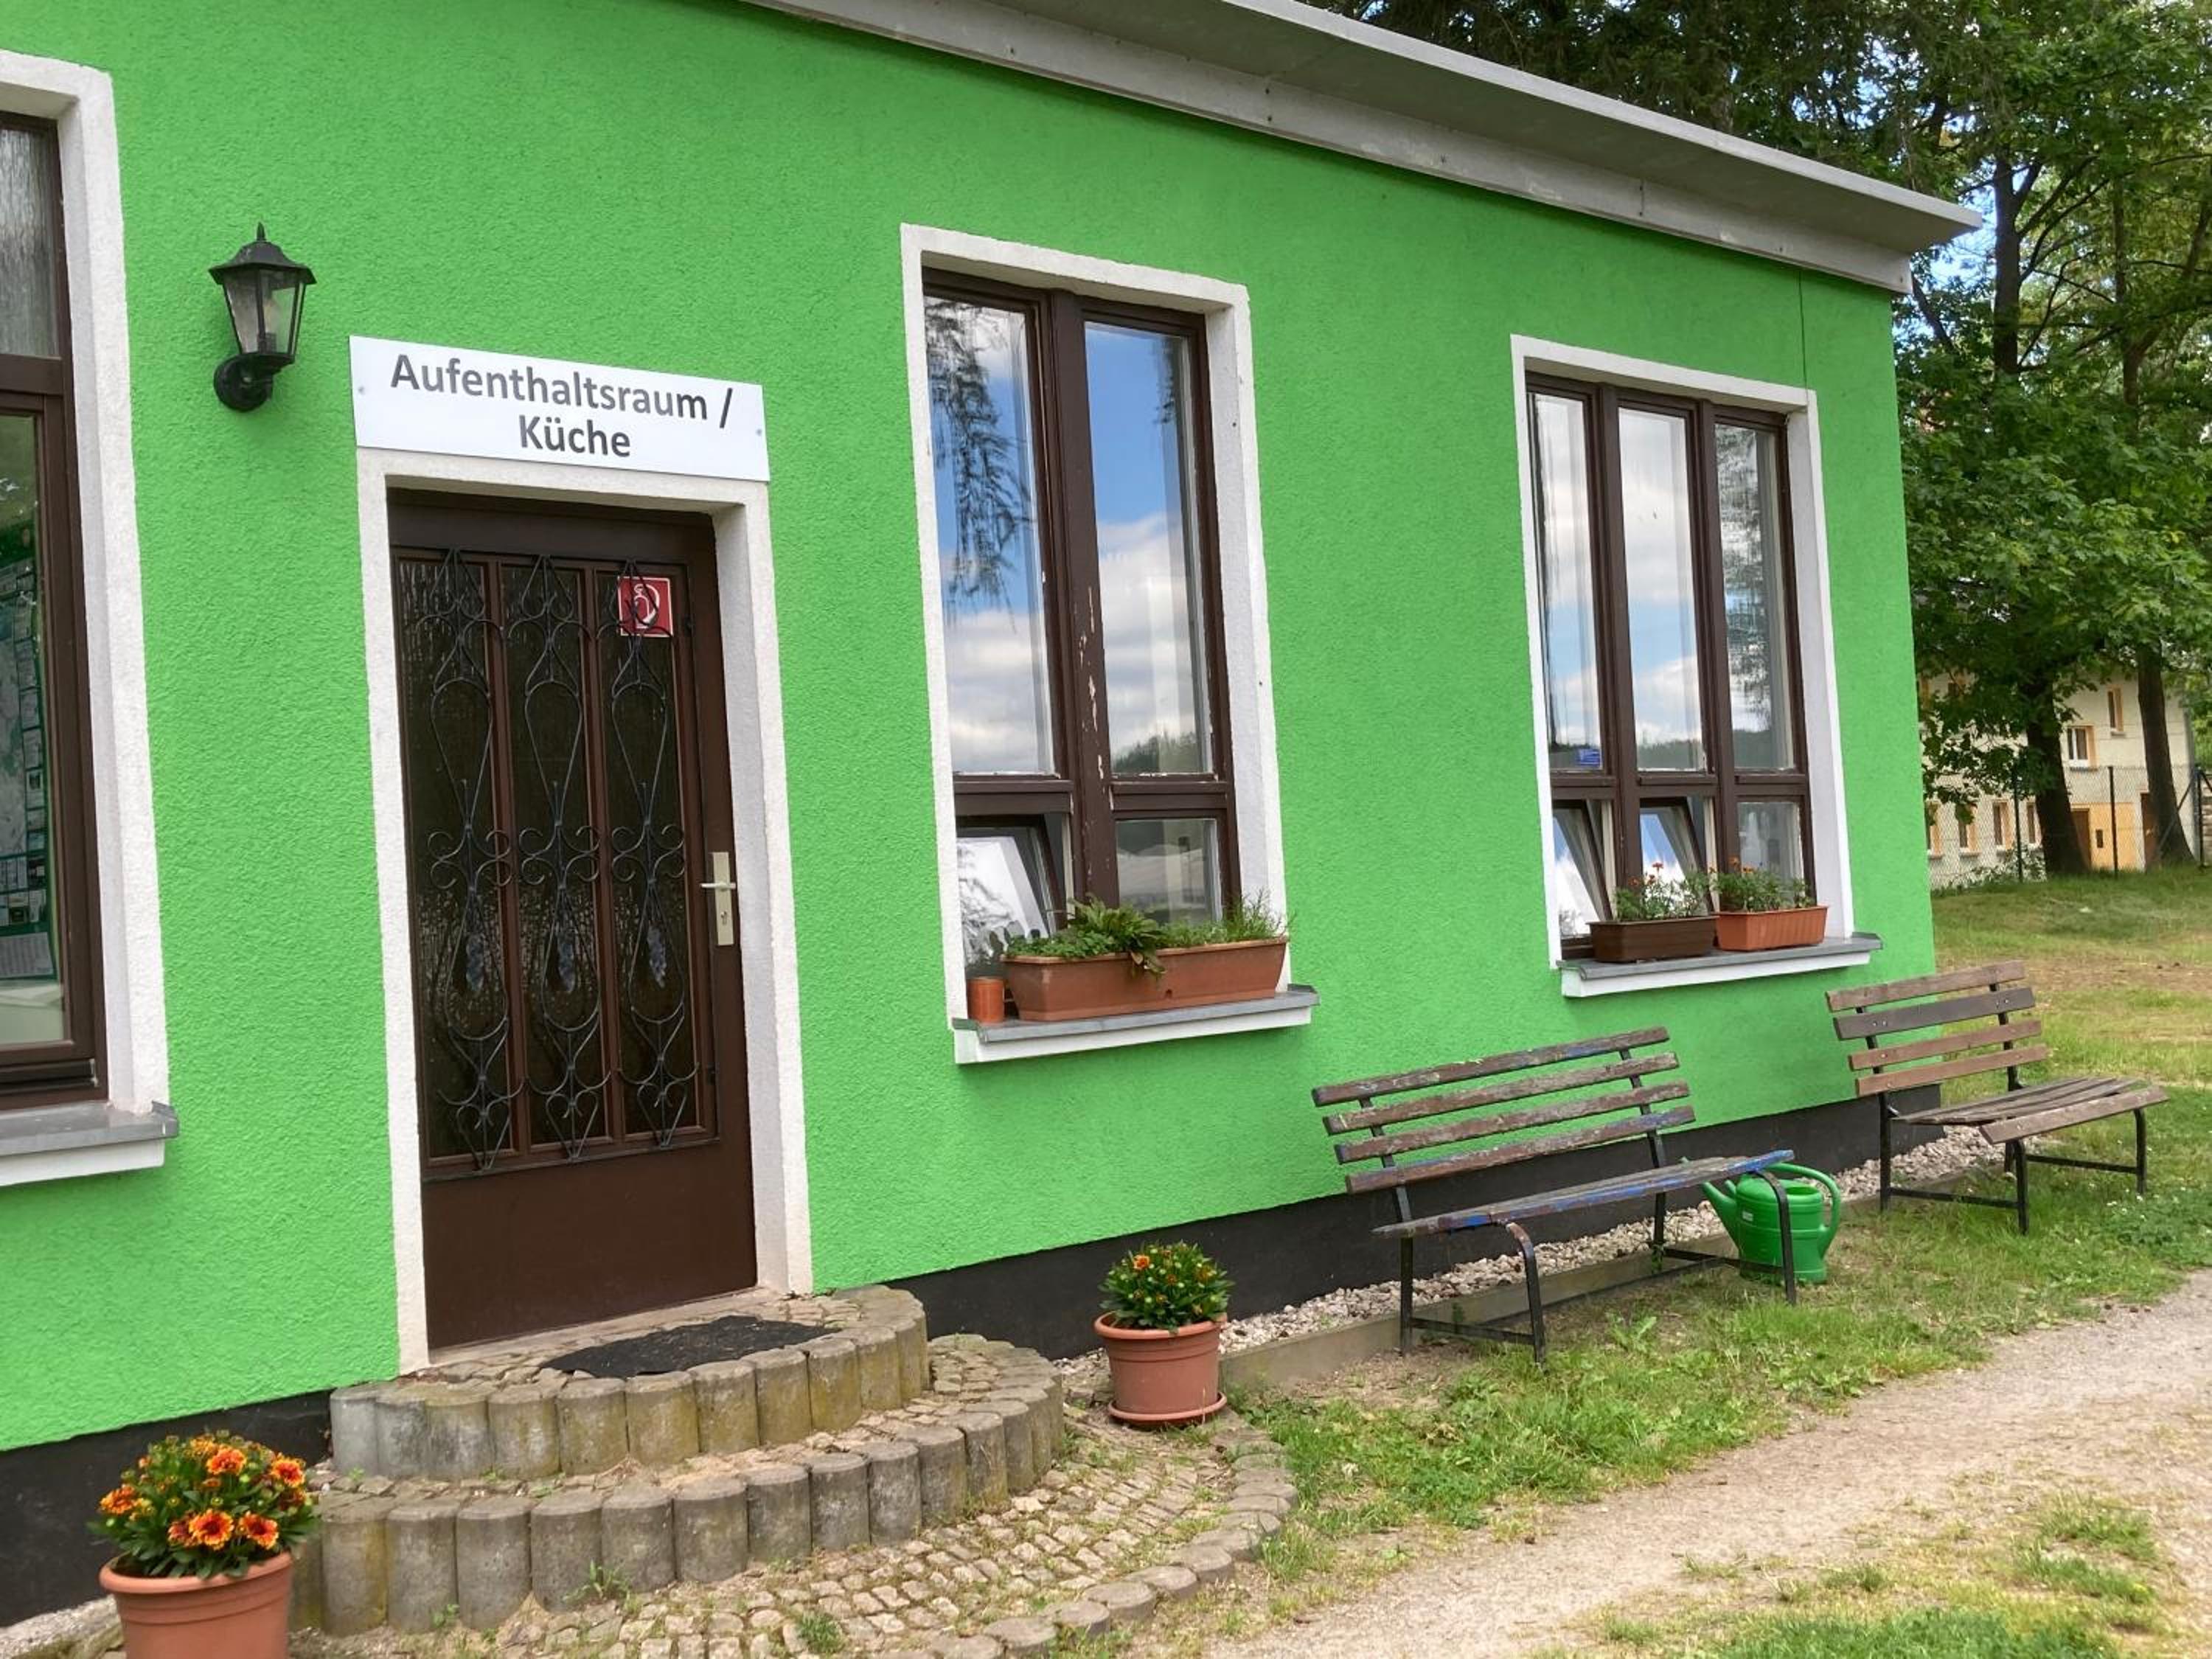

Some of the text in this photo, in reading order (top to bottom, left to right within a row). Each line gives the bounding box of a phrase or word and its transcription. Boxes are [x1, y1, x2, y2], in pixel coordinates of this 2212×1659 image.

[390, 354, 734, 429] Aufenthaltsraum /
[518, 415, 631, 457] Küche
